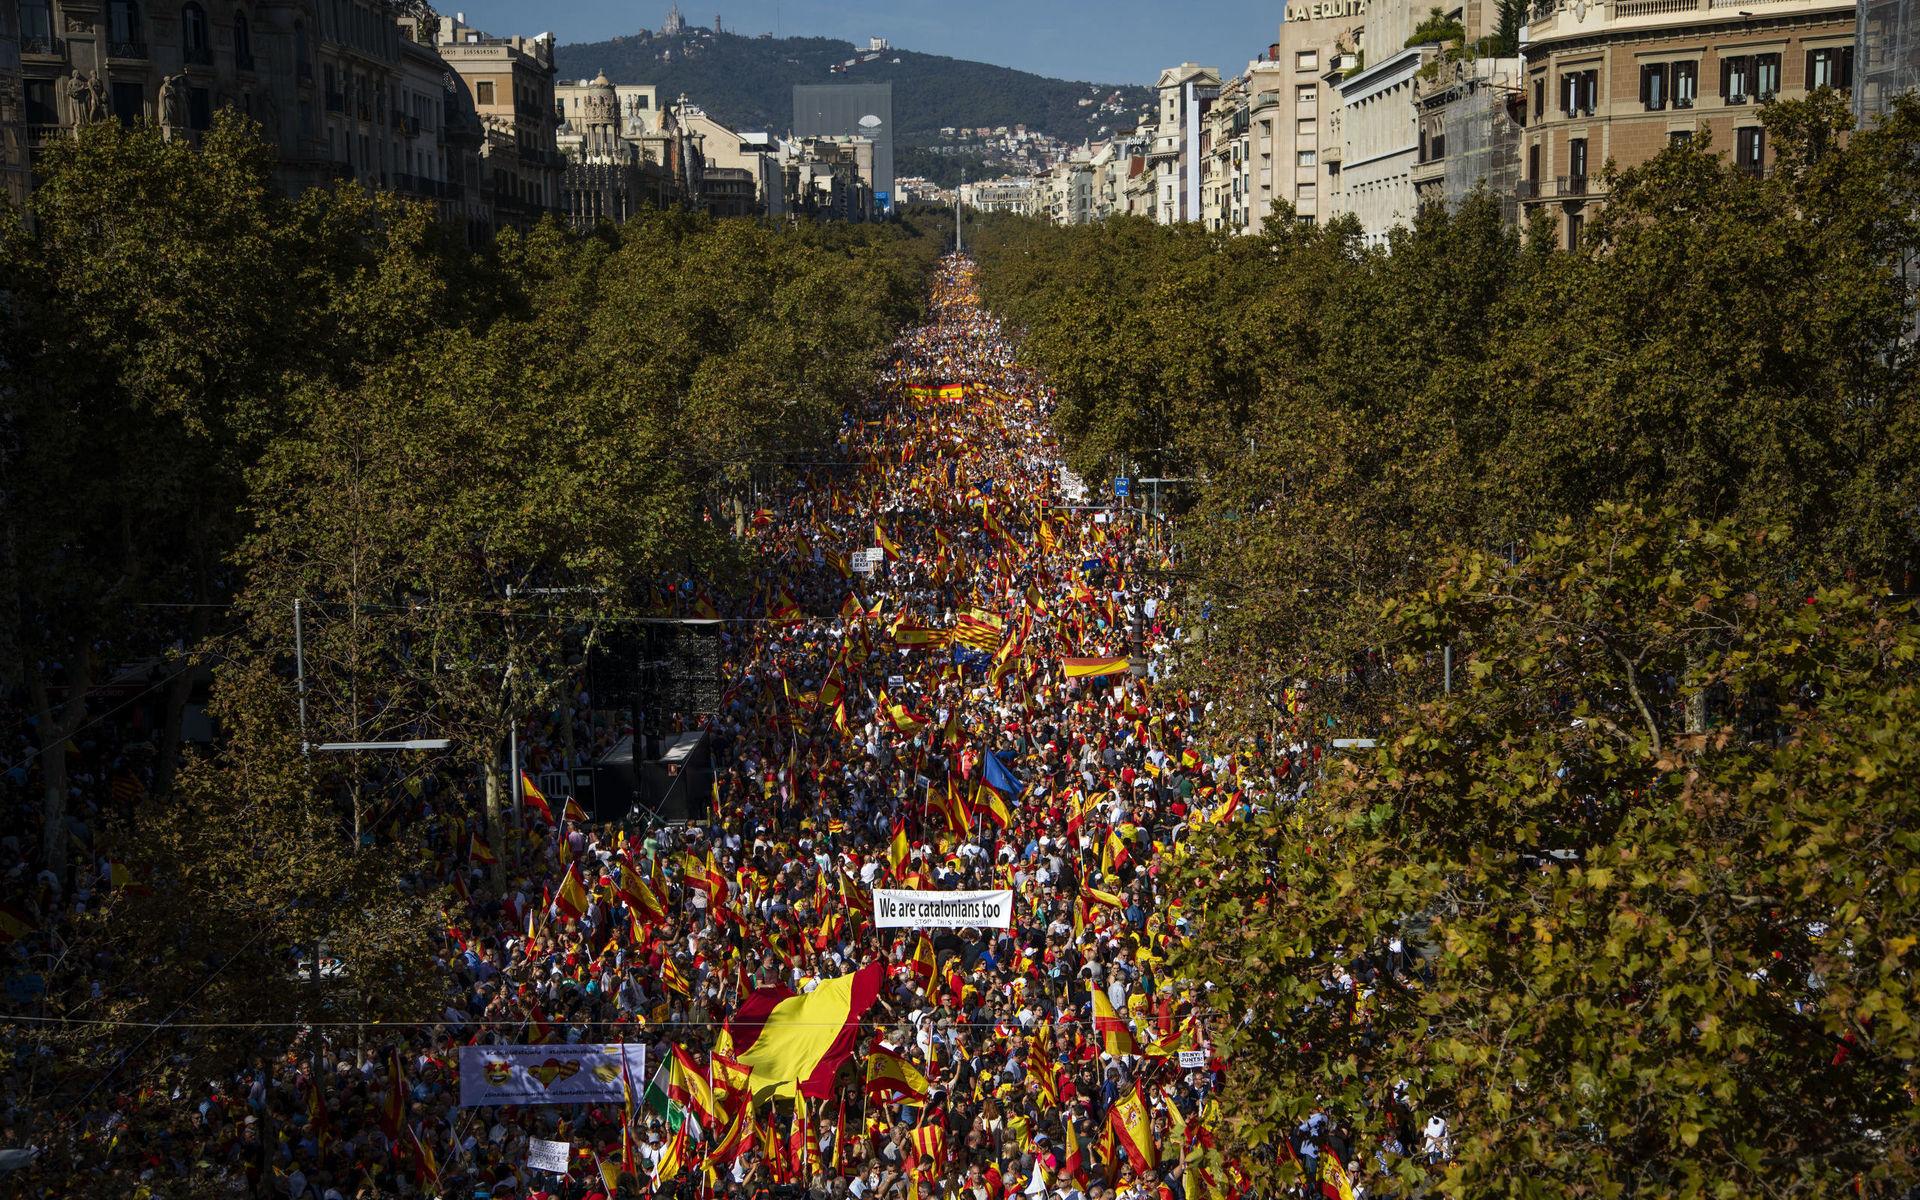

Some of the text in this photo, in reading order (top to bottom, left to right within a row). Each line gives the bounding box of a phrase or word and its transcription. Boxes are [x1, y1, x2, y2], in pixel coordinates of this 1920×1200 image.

[1284, 5, 1308, 21] LA
[880, 898, 1001, 918] We are catalonians too
